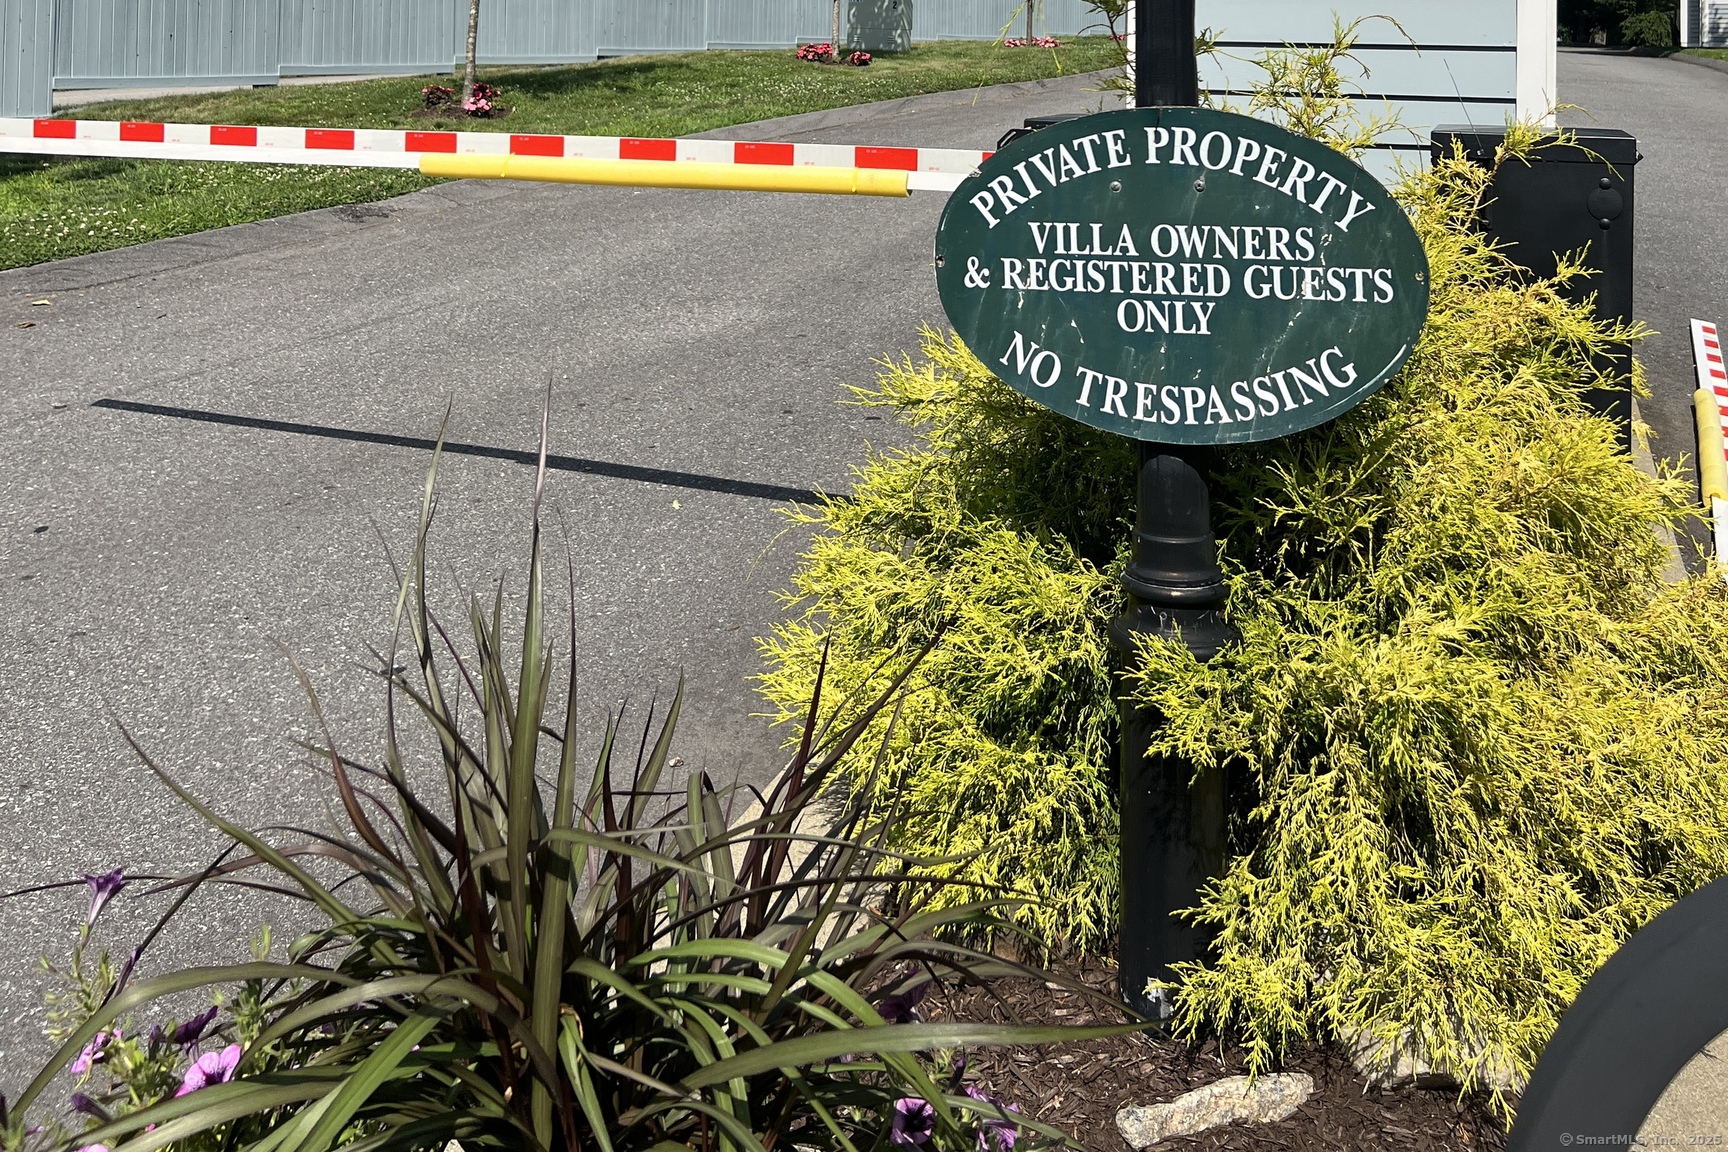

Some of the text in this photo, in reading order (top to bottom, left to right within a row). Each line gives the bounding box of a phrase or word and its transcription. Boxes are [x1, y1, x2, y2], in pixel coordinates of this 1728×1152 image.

[968, 126, 1376, 233] PRIVATE PROPERTY
[1027, 221, 1315, 262] VILLA OWNERS
[963, 256, 1394, 304] & REGISTERED GUESTS
[1116, 298, 1216, 335] ONLY
[999, 330, 1358, 425] NO TRESPASSING
